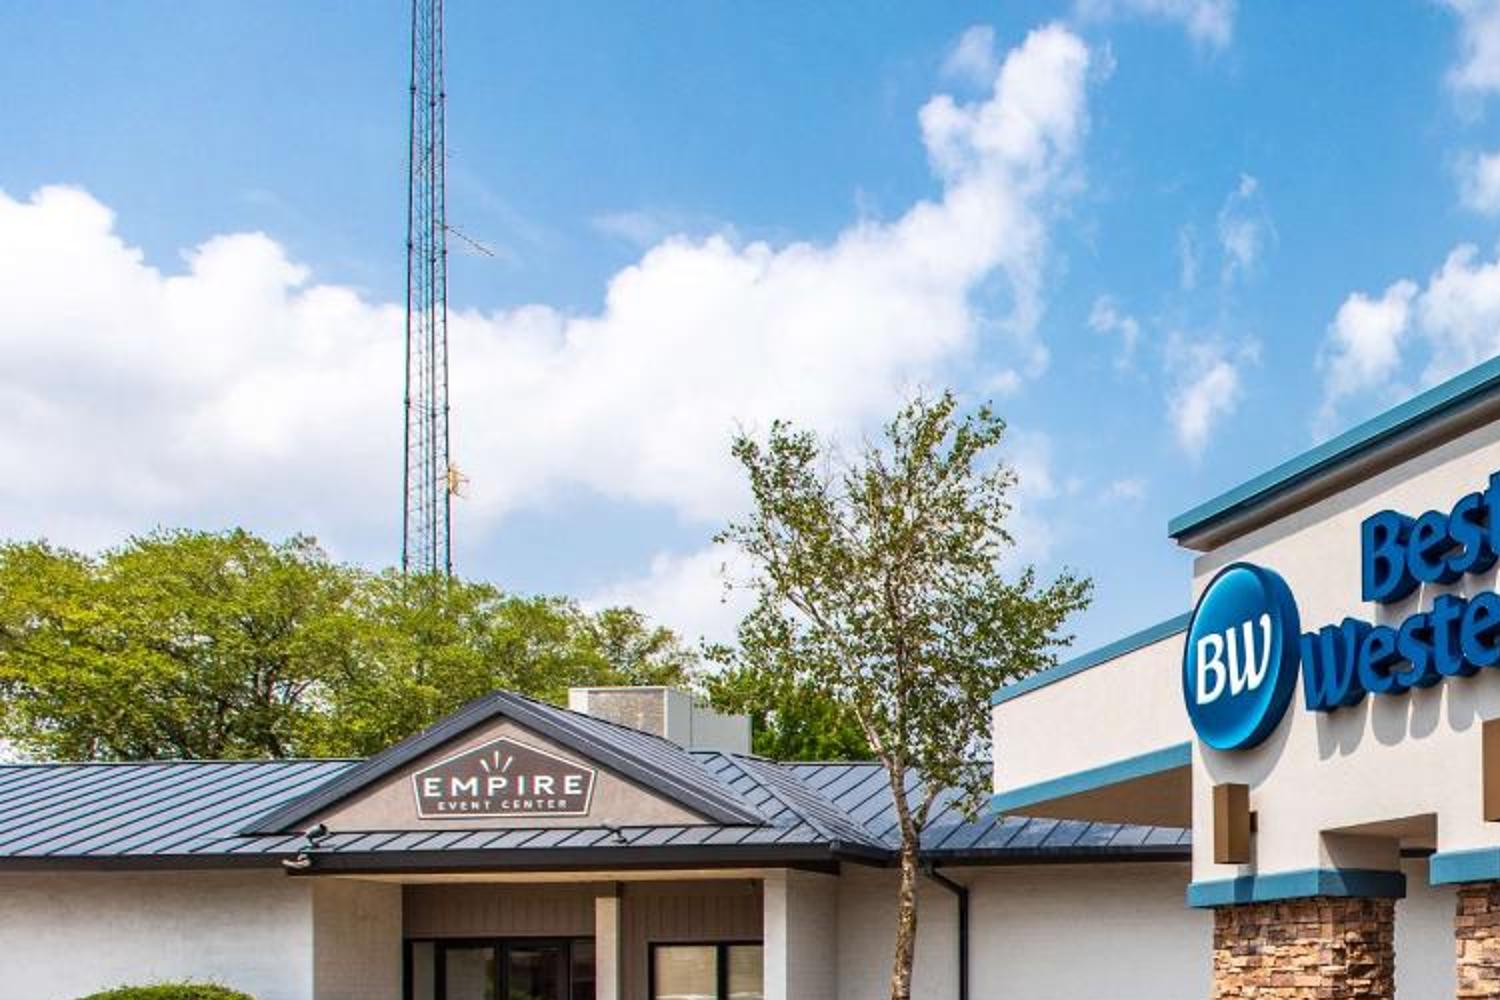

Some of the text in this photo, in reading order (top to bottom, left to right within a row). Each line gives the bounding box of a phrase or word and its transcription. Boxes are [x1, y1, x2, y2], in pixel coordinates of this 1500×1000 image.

[1196, 613, 1272, 705] BW
[423, 775, 583, 797] EMPIRE
[437, 799, 567, 811] EVENT CENTER
